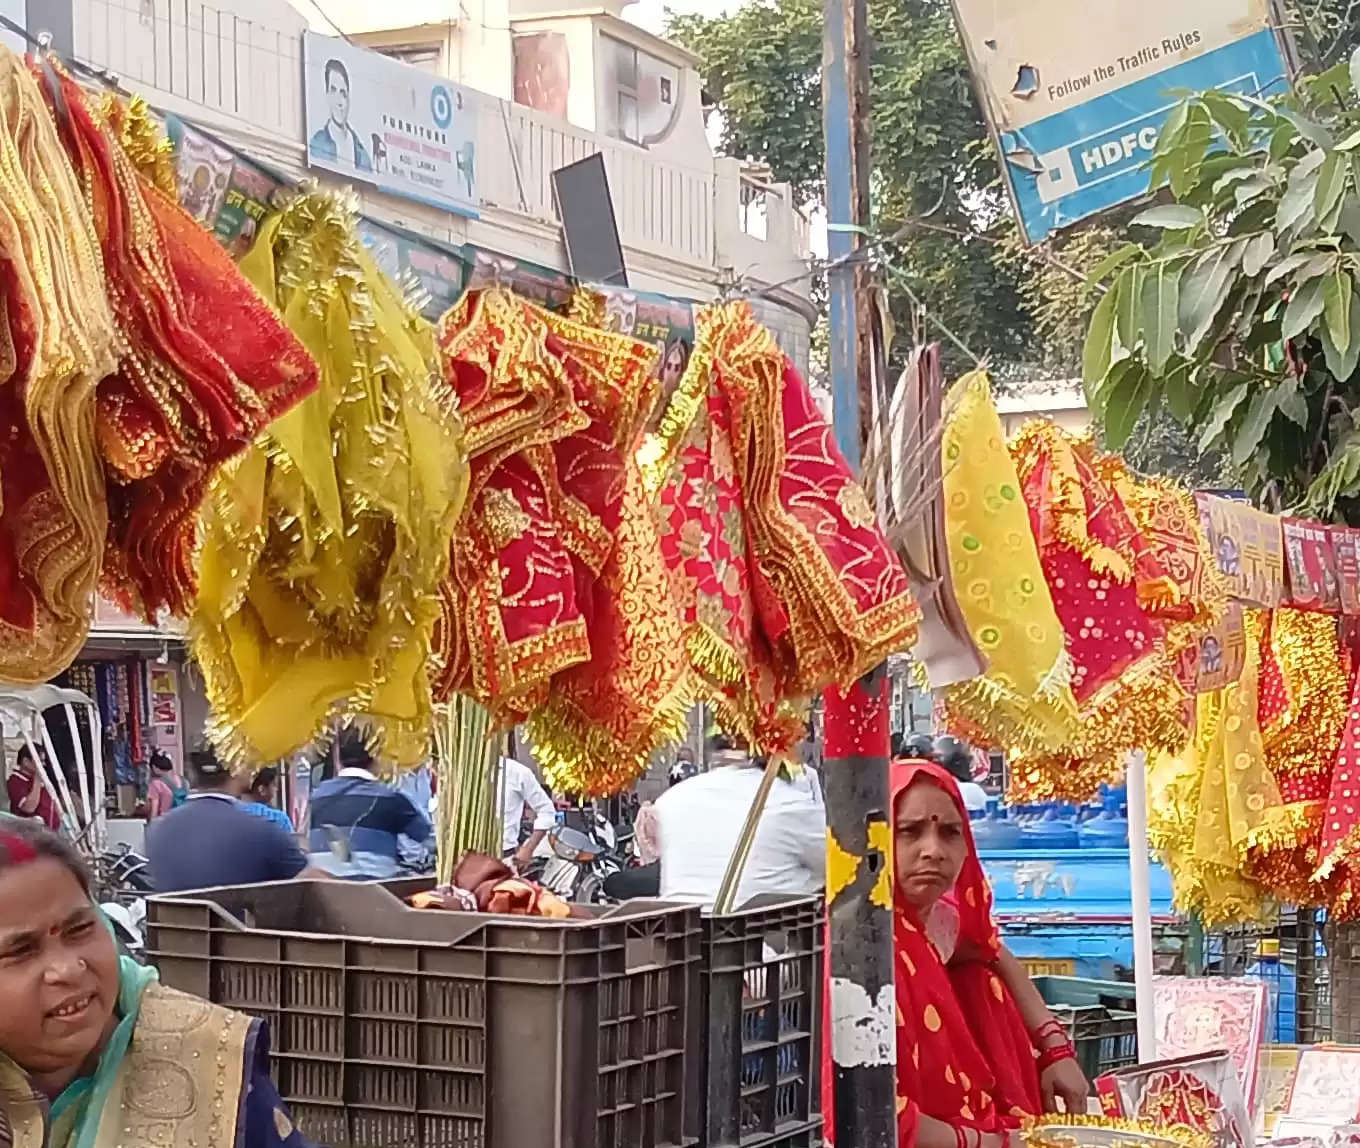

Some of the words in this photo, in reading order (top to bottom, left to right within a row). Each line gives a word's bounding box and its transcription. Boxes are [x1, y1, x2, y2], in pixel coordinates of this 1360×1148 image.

[1048, 73, 1091, 102] Follow
[1094, 64, 1116, 83] the
[1117, 46, 1160, 72] Traffic
[1161, 29, 1202, 56] Rules
[382, 114, 446, 144] FURNITURE
[1081, 127, 1158, 174] HDFC
